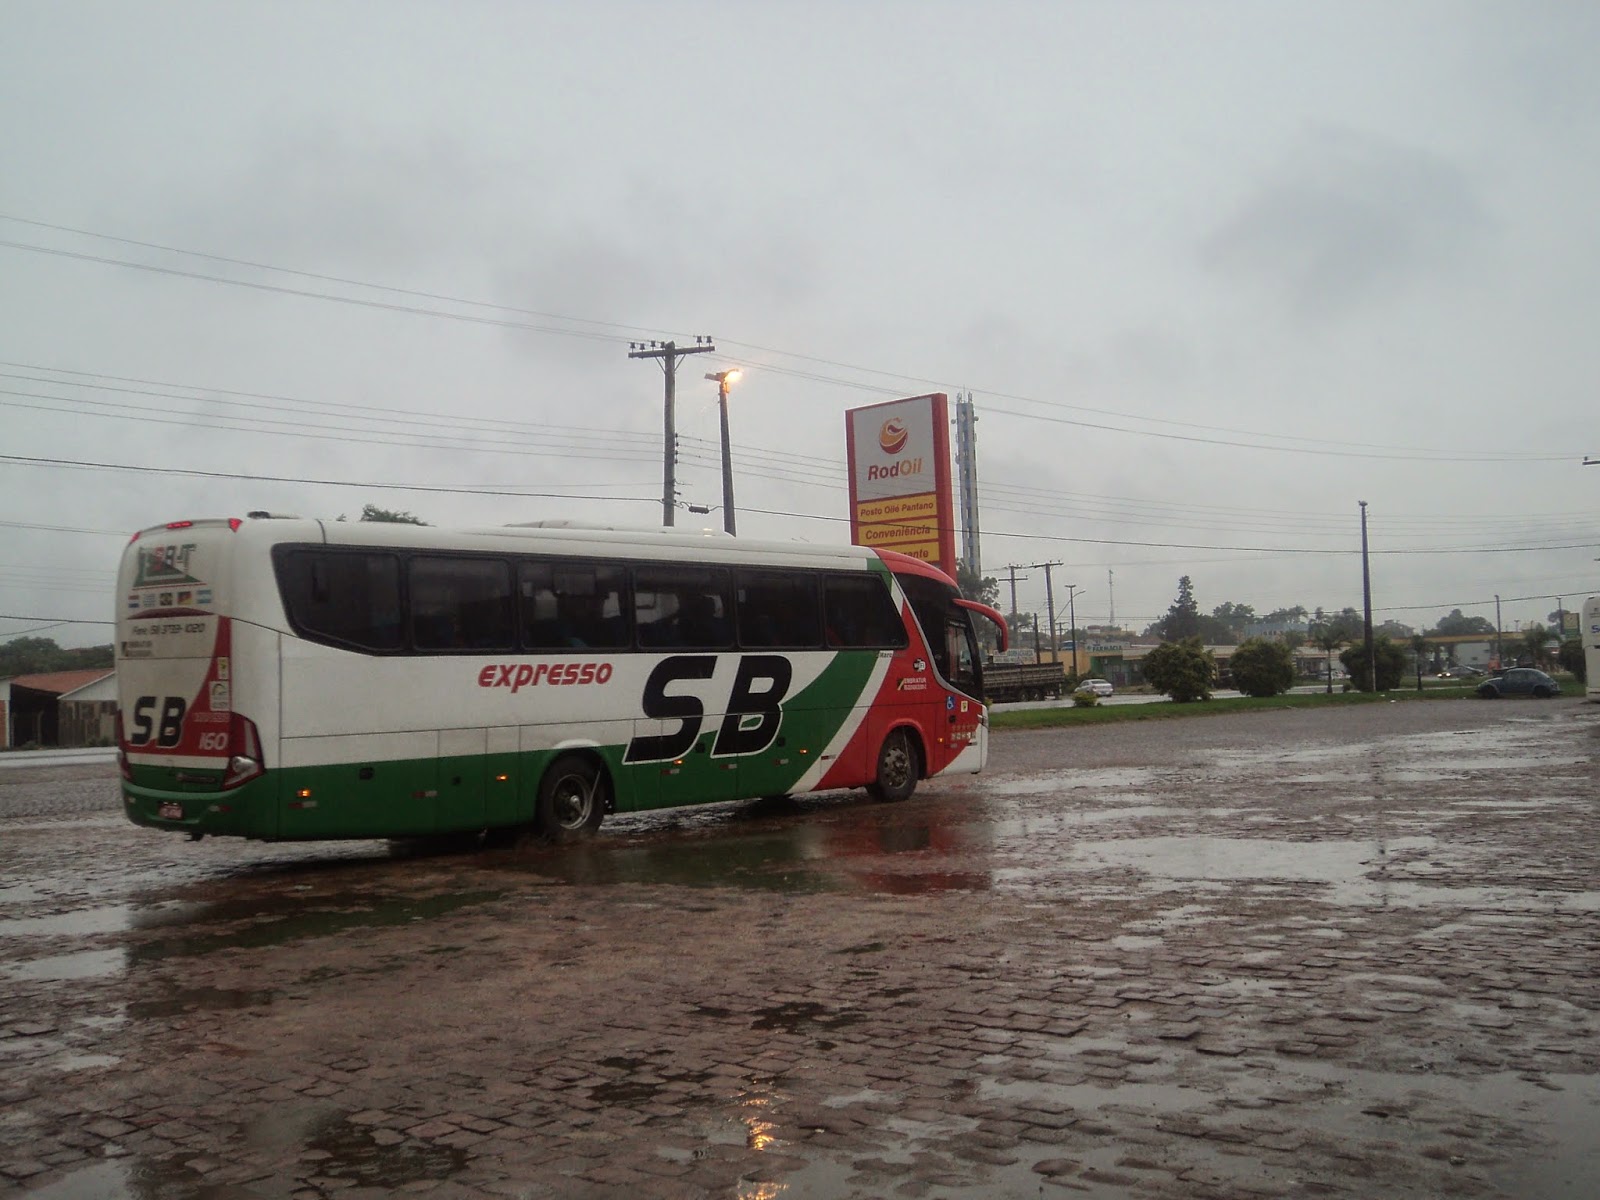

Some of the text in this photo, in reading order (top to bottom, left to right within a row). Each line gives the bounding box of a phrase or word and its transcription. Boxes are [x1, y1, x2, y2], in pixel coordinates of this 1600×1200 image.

[867, 458, 924, 481] RodOil
[860, 508, 883, 516] Posto
[901, 502, 934, 512] Pantano
[622, 655, 793, 764] SB
[130, 696, 187, 748] SB
[199, 732, 229, 750] 160
